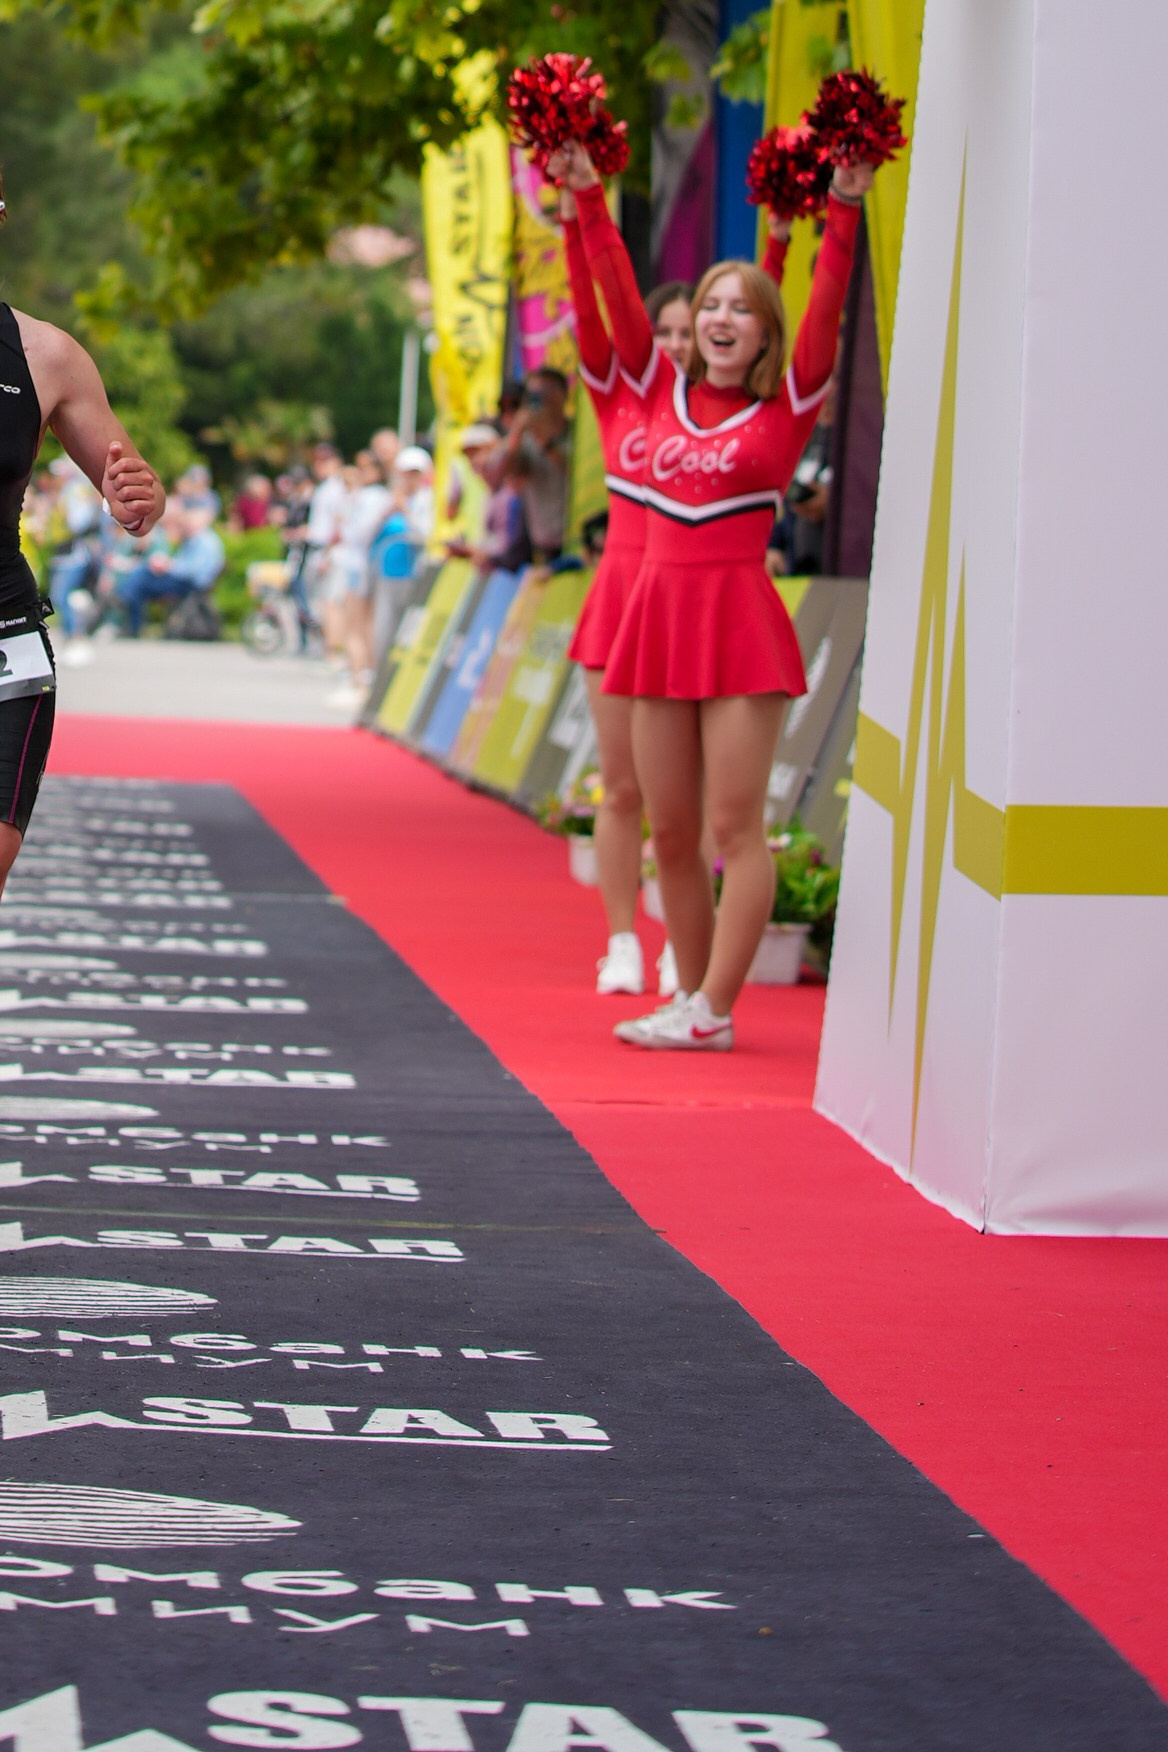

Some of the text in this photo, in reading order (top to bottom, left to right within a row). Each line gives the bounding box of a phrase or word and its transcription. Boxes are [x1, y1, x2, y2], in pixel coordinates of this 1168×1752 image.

[651, 434, 741, 482] Cool
[87, 1164, 422, 1197] STAR
[96, 1229, 466, 1257] STAR
[141, 1395, 611, 1442] STAR
[207, 1690, 846, 1752] STAR
